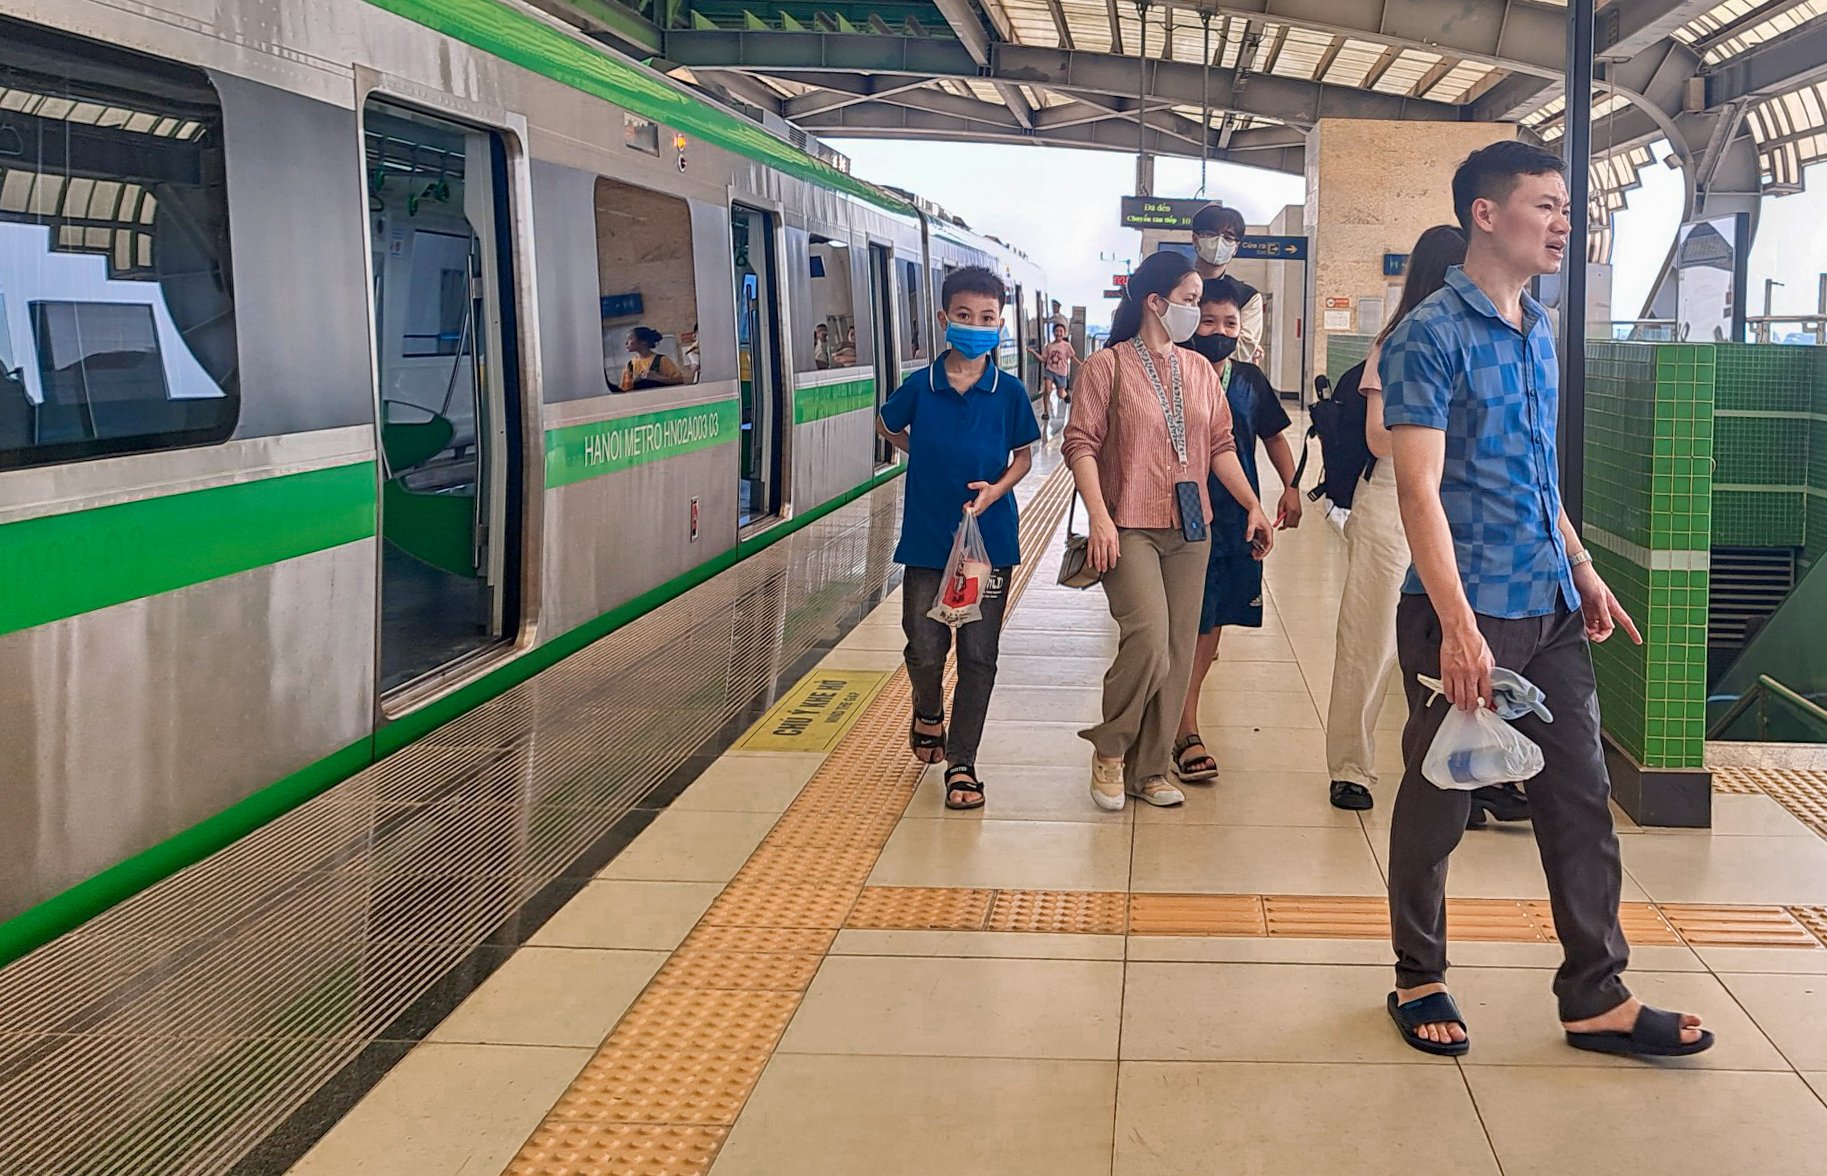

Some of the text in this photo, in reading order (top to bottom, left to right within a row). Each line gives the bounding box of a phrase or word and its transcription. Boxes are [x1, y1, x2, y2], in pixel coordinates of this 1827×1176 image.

[584, 430, 622, 467] HANOI
[624, 423, 662, 457] METRO
[708, 412, 719, 438] 03
[773, 717, 813, 736] CHÚ
[799, 692, 837, 708] KHE
